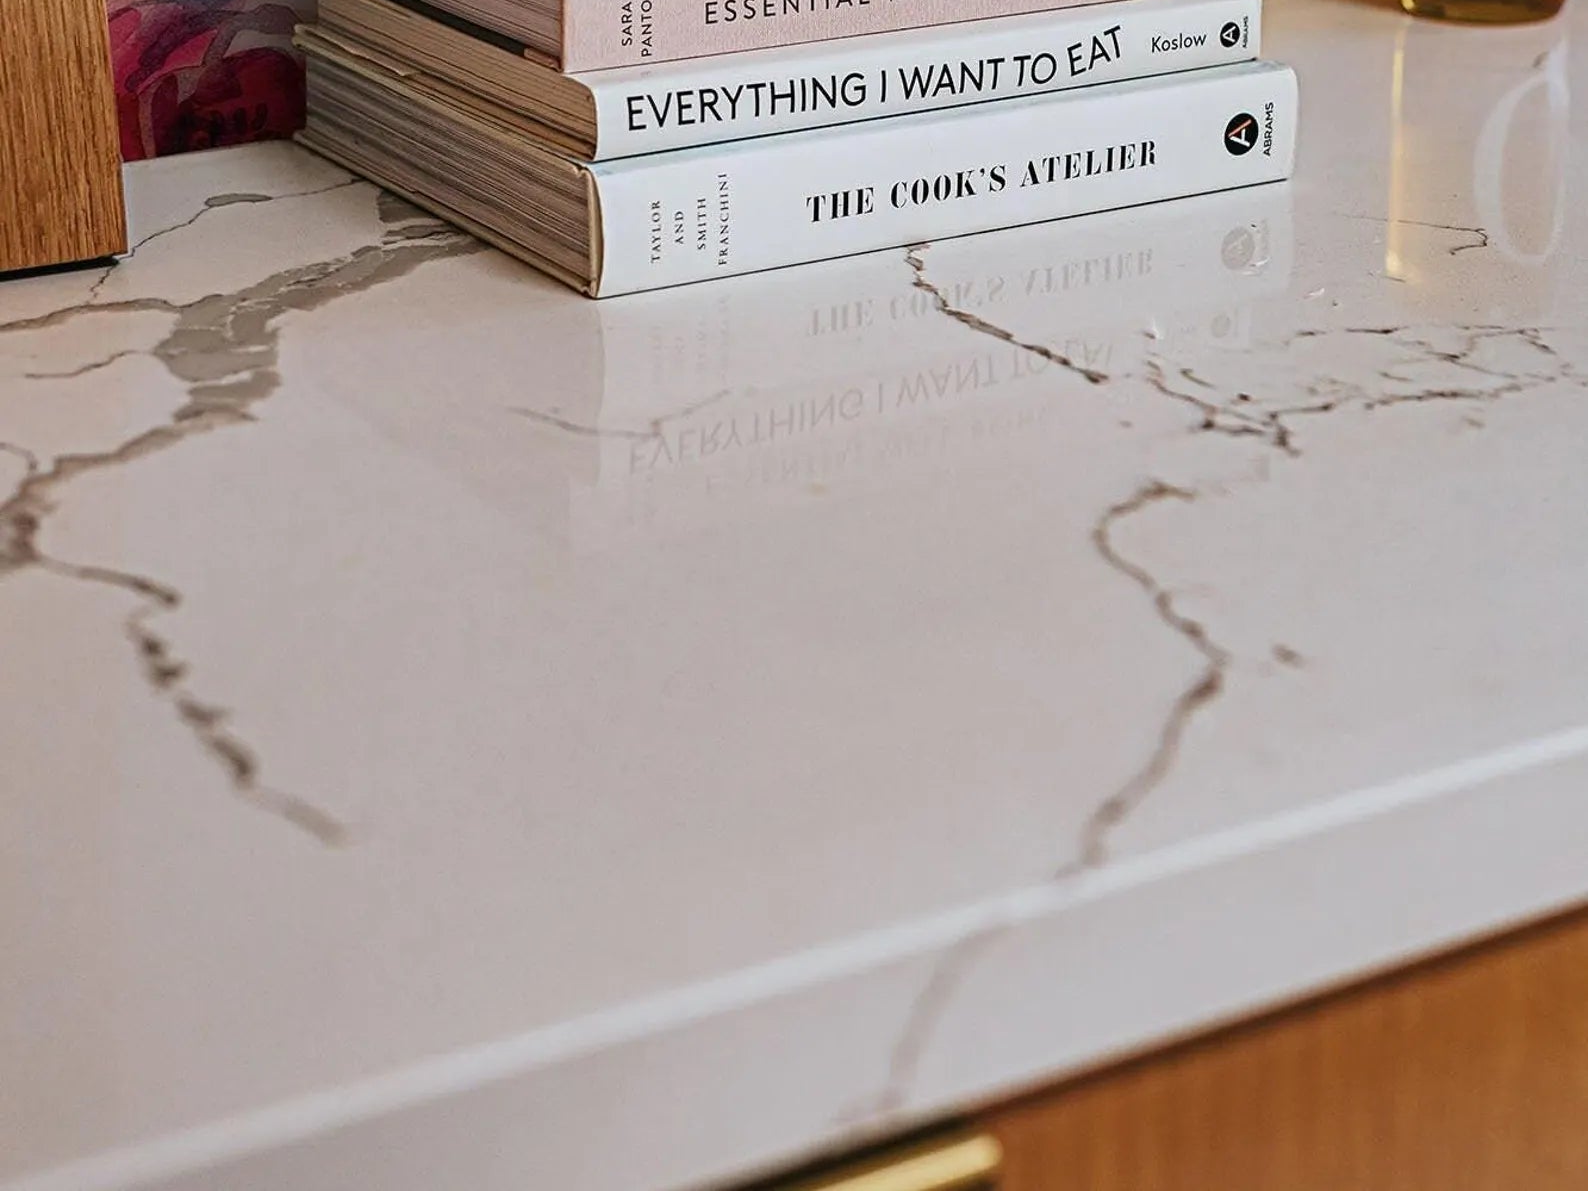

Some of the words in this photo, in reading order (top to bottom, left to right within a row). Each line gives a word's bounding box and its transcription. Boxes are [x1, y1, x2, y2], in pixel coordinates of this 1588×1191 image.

[620, 1, 633, 47] SARA
[1151, 32, 1207, 53] Koslow
[626, 72, 867, 131] EVERYTHING
[880, 69, 888, 103] I
[898, 57, 1006, 100] WANT
[1012, 52, 1057, 87] TO
[1066, 25, 1123, 77] EAT
[1263, 101, 1275, 157] ABRAMS
[806, 188, 874, 223] THE
[890, 165, 1006, 209] COOK'S
[1021, 140, 1156, 188] ATELIER
[650, 200, 662, 264] TAYLOR
[674, 210, 684, 245] AND
[697, 198, 707, 250] SMITH
[717, 173, 729, 266] FRANCHINI
